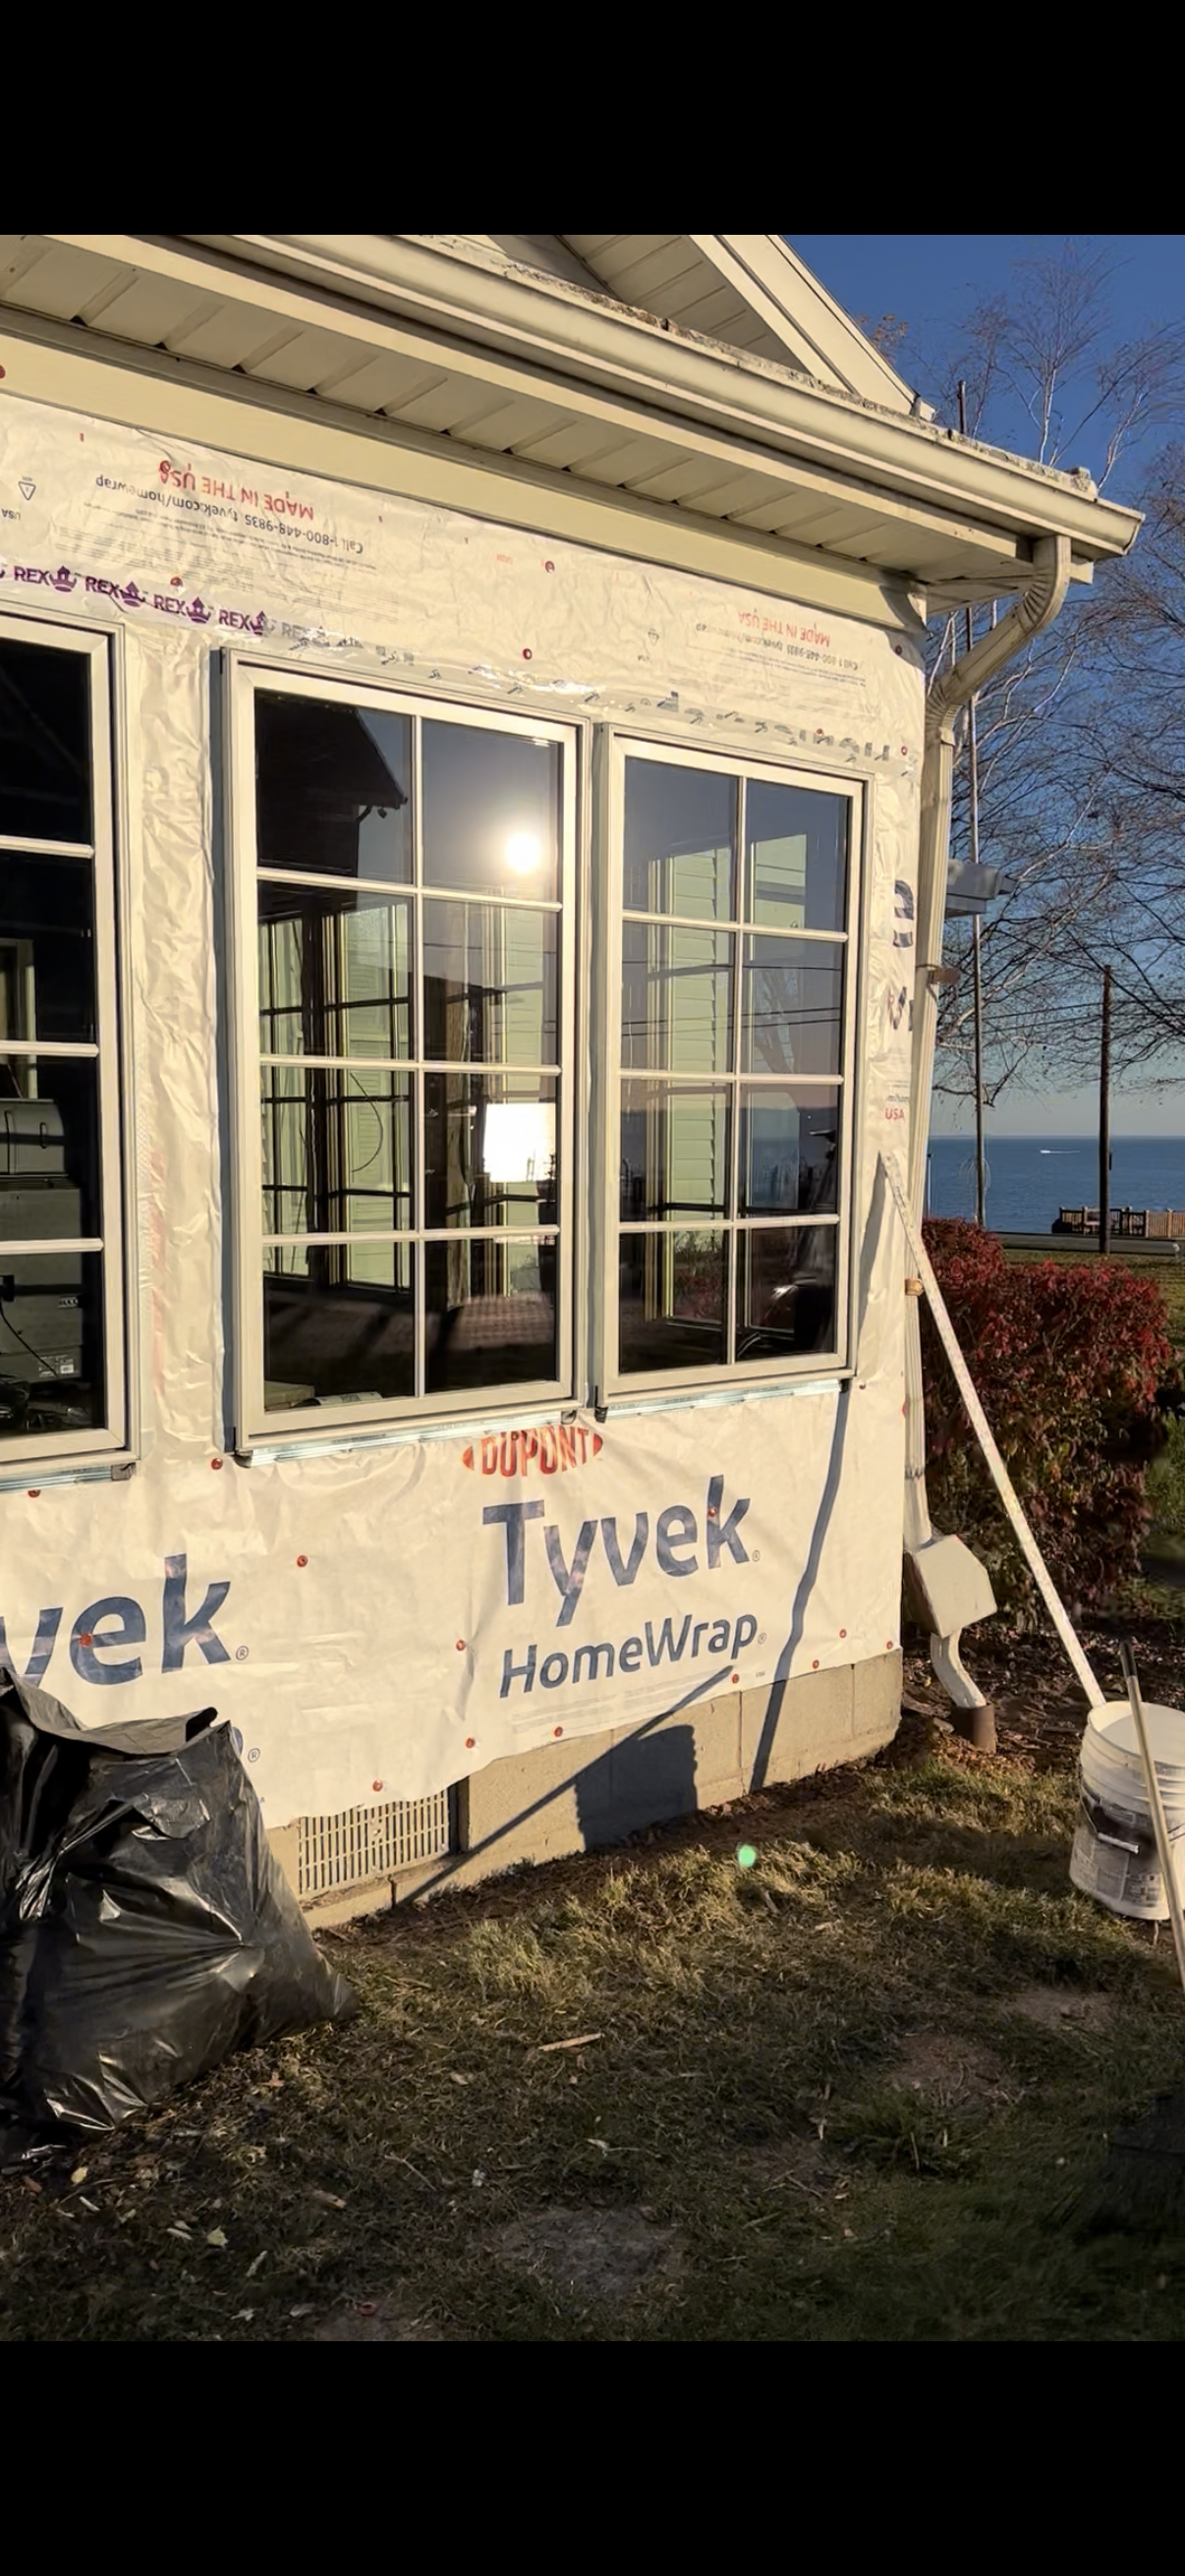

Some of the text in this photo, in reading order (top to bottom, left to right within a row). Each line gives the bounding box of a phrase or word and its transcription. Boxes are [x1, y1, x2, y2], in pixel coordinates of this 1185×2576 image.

[159, 467, 313, 520] MADE IN THE USA
[340, 536, 365, 554] Call
[14, 565, 51, 586] REX
[85, 576, 120, 598] REX
[153, 593, 187, 616] REX
[218, 609, 253, 631] REX
[738, 611, 830, 647] MADE IN THE USA
[885, 1107, 905, 1121] USA
[480, 1426, 591, 1477] DUPONT
